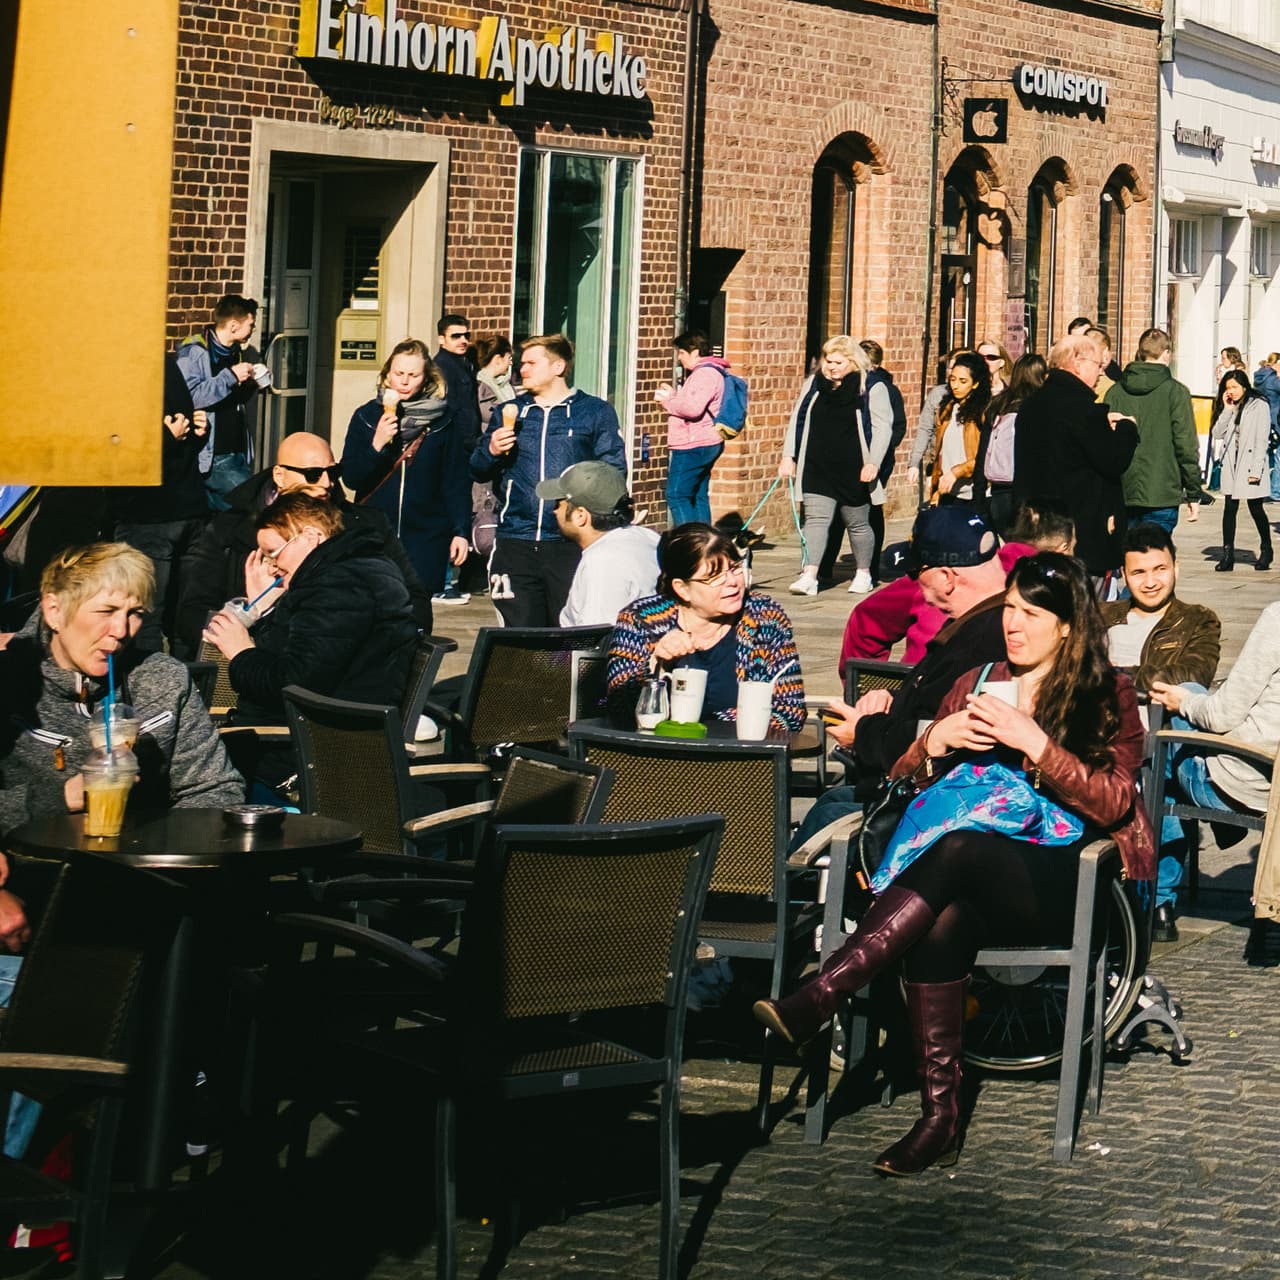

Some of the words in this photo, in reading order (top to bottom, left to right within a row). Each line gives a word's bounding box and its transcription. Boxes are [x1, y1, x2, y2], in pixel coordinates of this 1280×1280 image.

[487, 17, 647, 107] Apotheke
[1020, 64, 1109, 108] COMSPOT
[490, 573, 515, 599] 21
